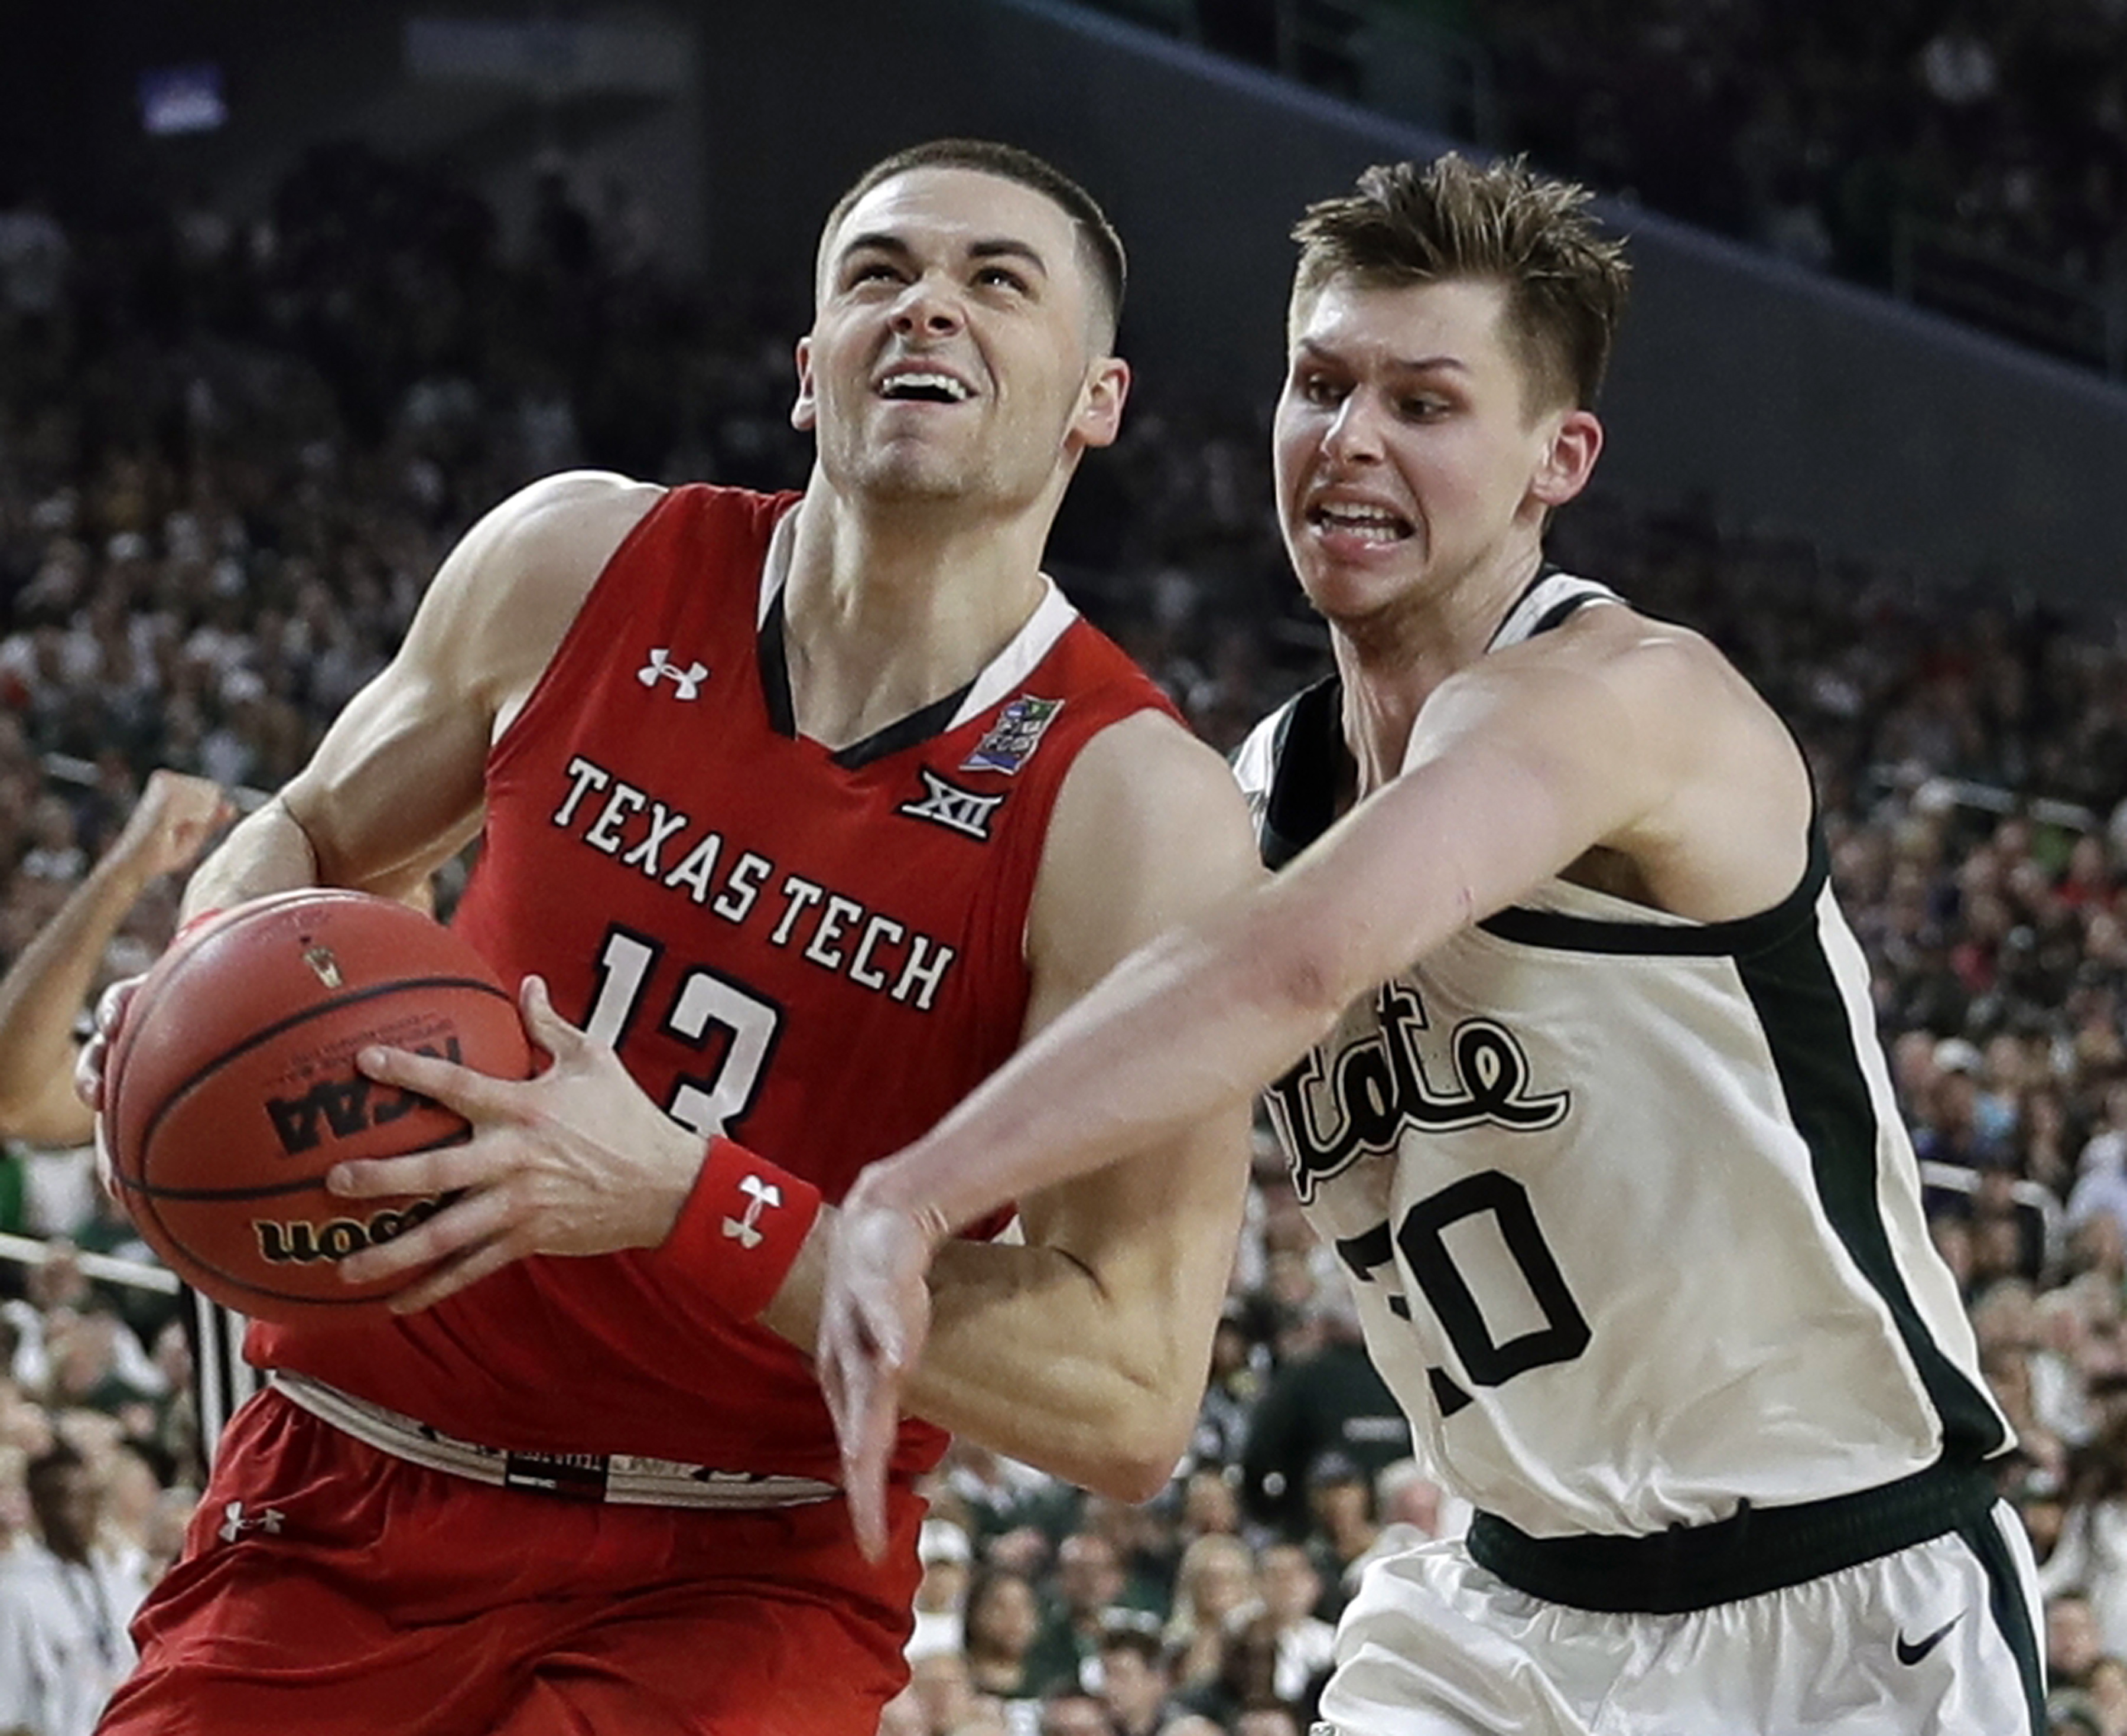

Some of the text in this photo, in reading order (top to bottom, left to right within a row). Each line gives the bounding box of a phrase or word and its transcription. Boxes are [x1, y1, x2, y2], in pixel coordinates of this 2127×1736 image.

[552, 755, 955, 1012] TEXAS TECH
[584, 926, 781, 1138] 13
[1264, 979, 1570, 1205] tate
